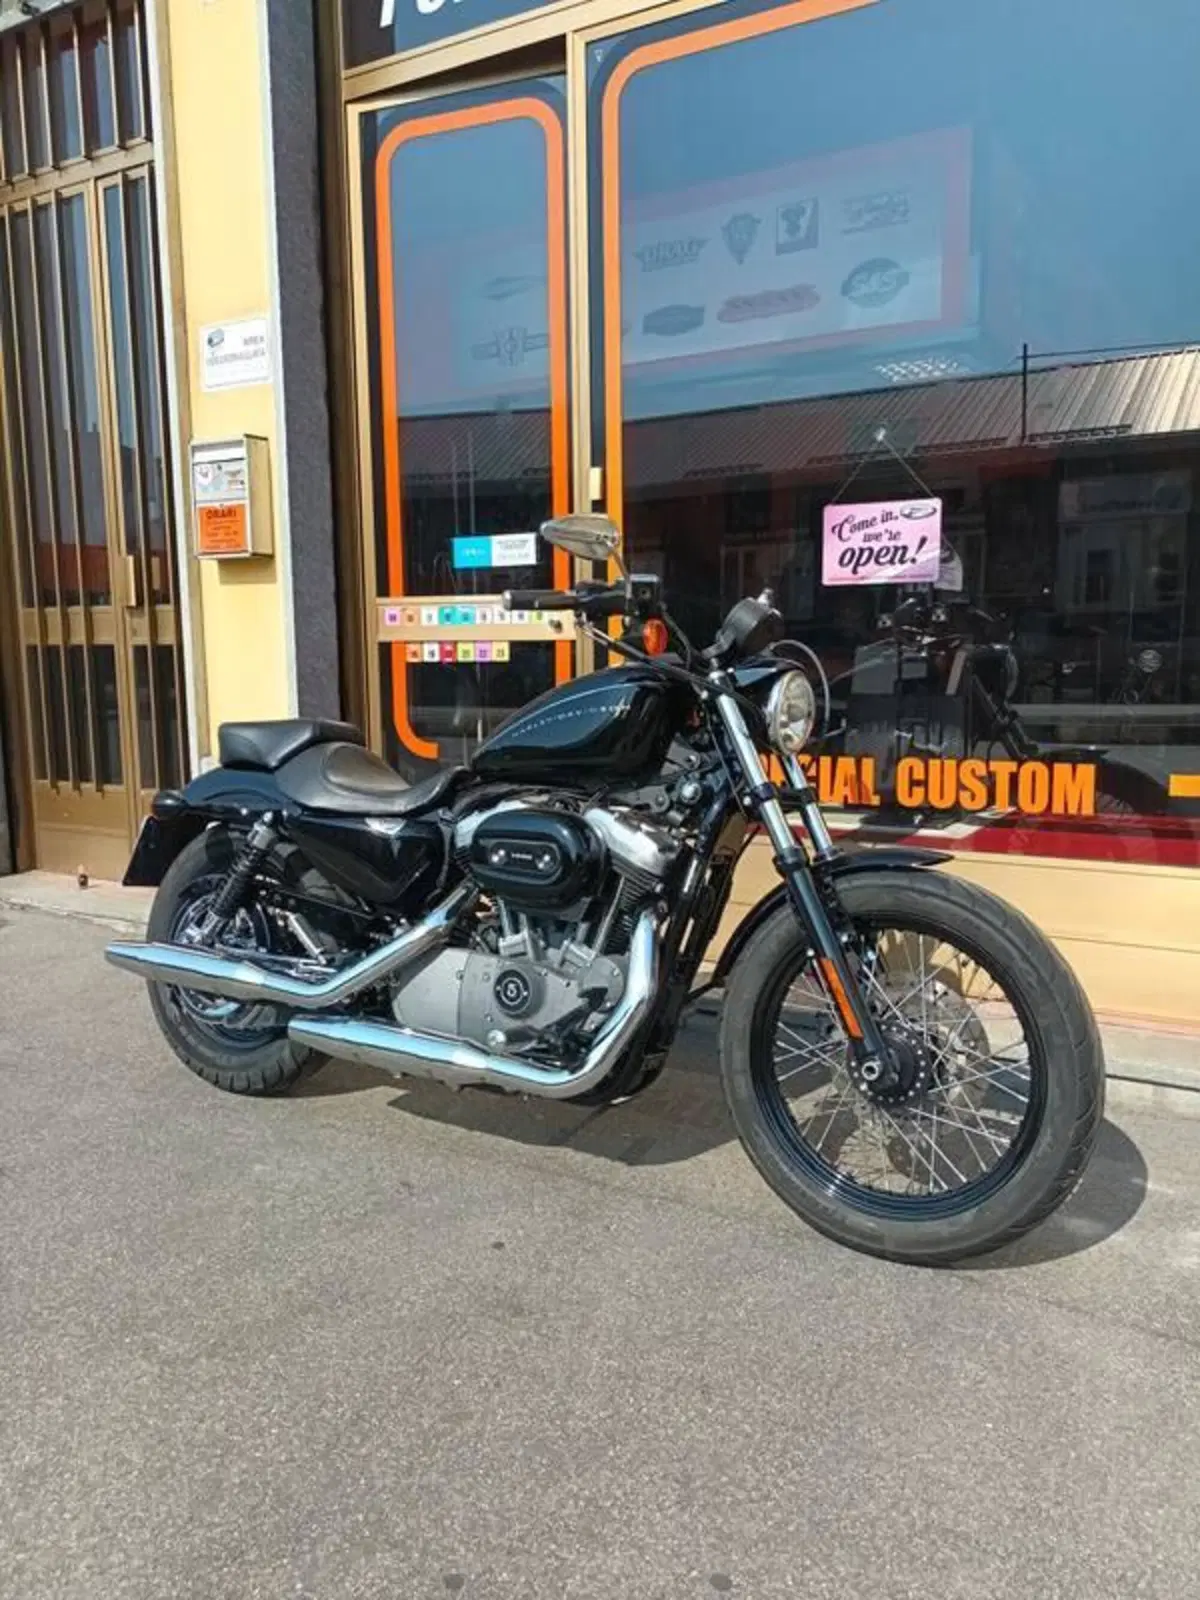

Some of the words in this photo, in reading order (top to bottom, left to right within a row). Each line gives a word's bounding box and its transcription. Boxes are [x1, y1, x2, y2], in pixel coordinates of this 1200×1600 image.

[831, 514, 878, 543] Come
[838, 535, 929, 576] open!
[896, 756, 1097, 817] CUSTOM
